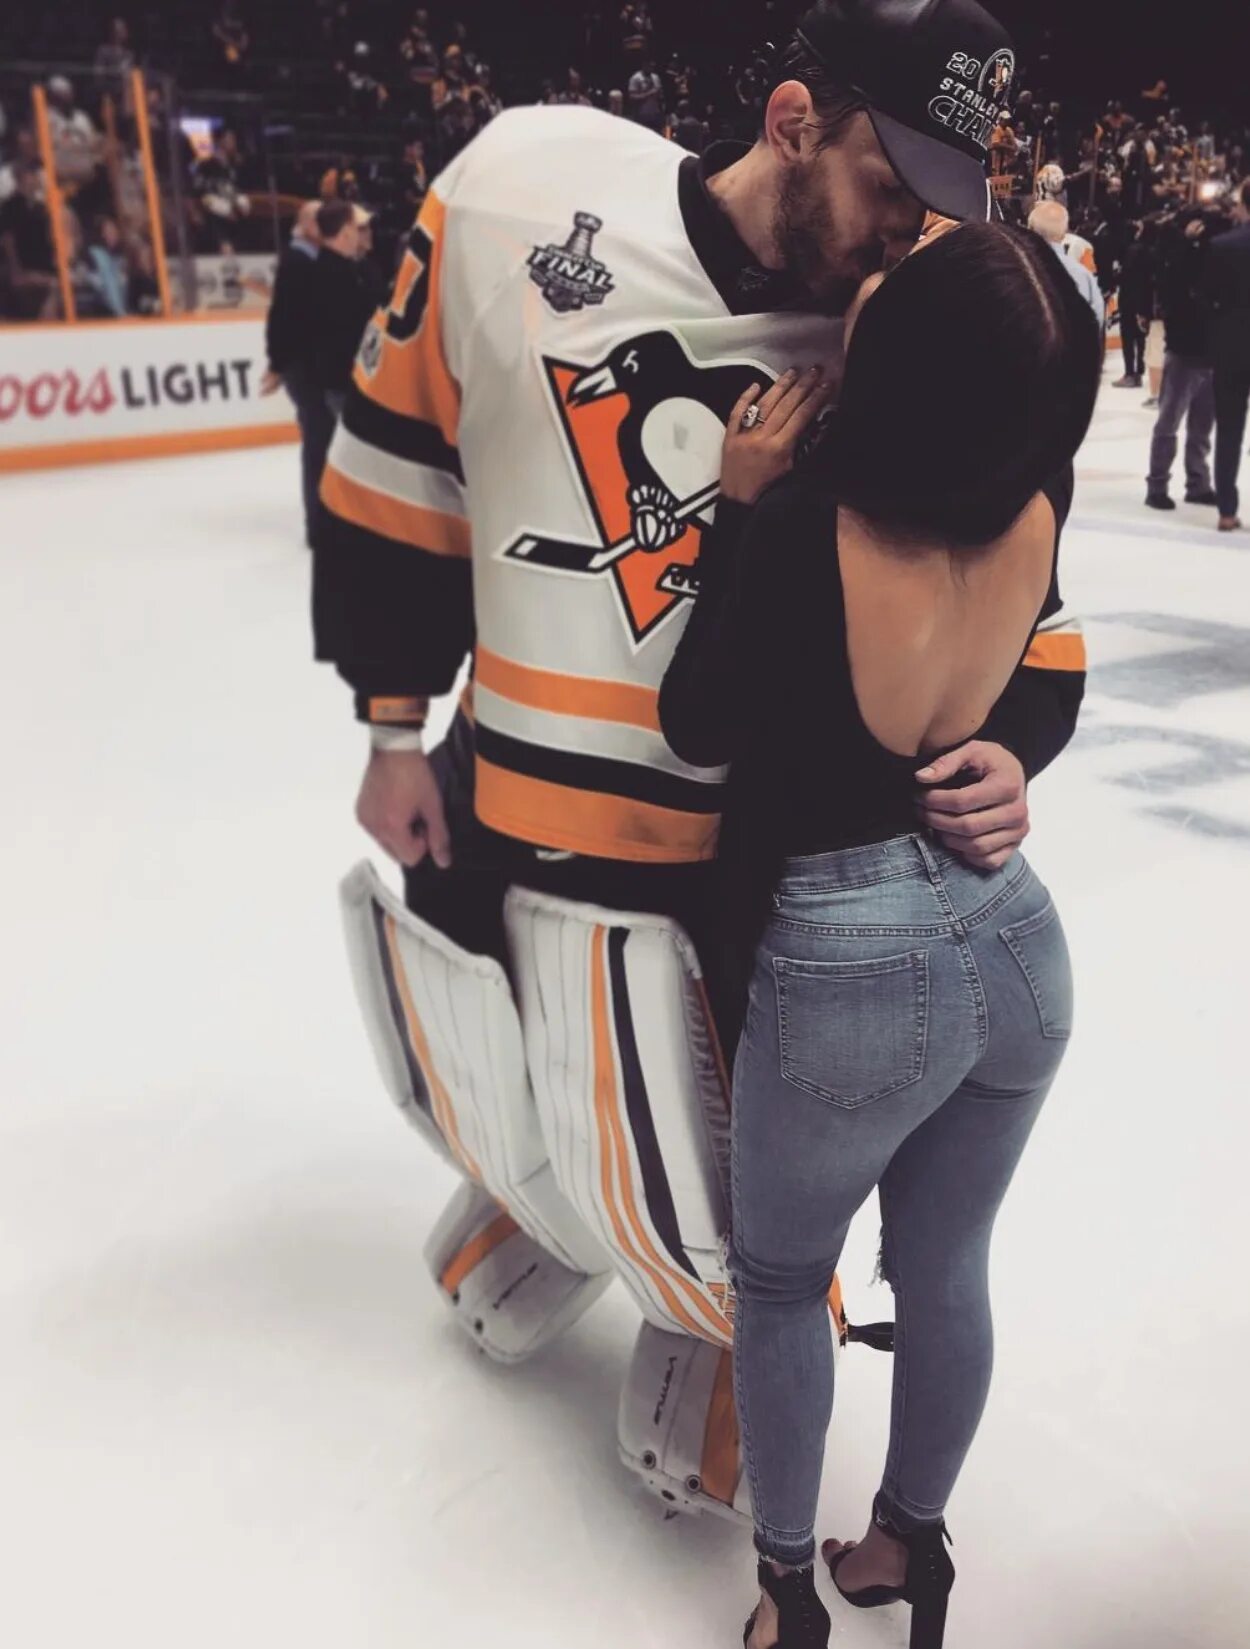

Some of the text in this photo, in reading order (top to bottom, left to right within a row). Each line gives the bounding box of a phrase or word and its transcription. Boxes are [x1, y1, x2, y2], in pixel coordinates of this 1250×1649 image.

[946, 51, 981, 80] 20
[532, 251, 609, 289] FINAL
[0, 359, 253, 423] oors LIGHT
